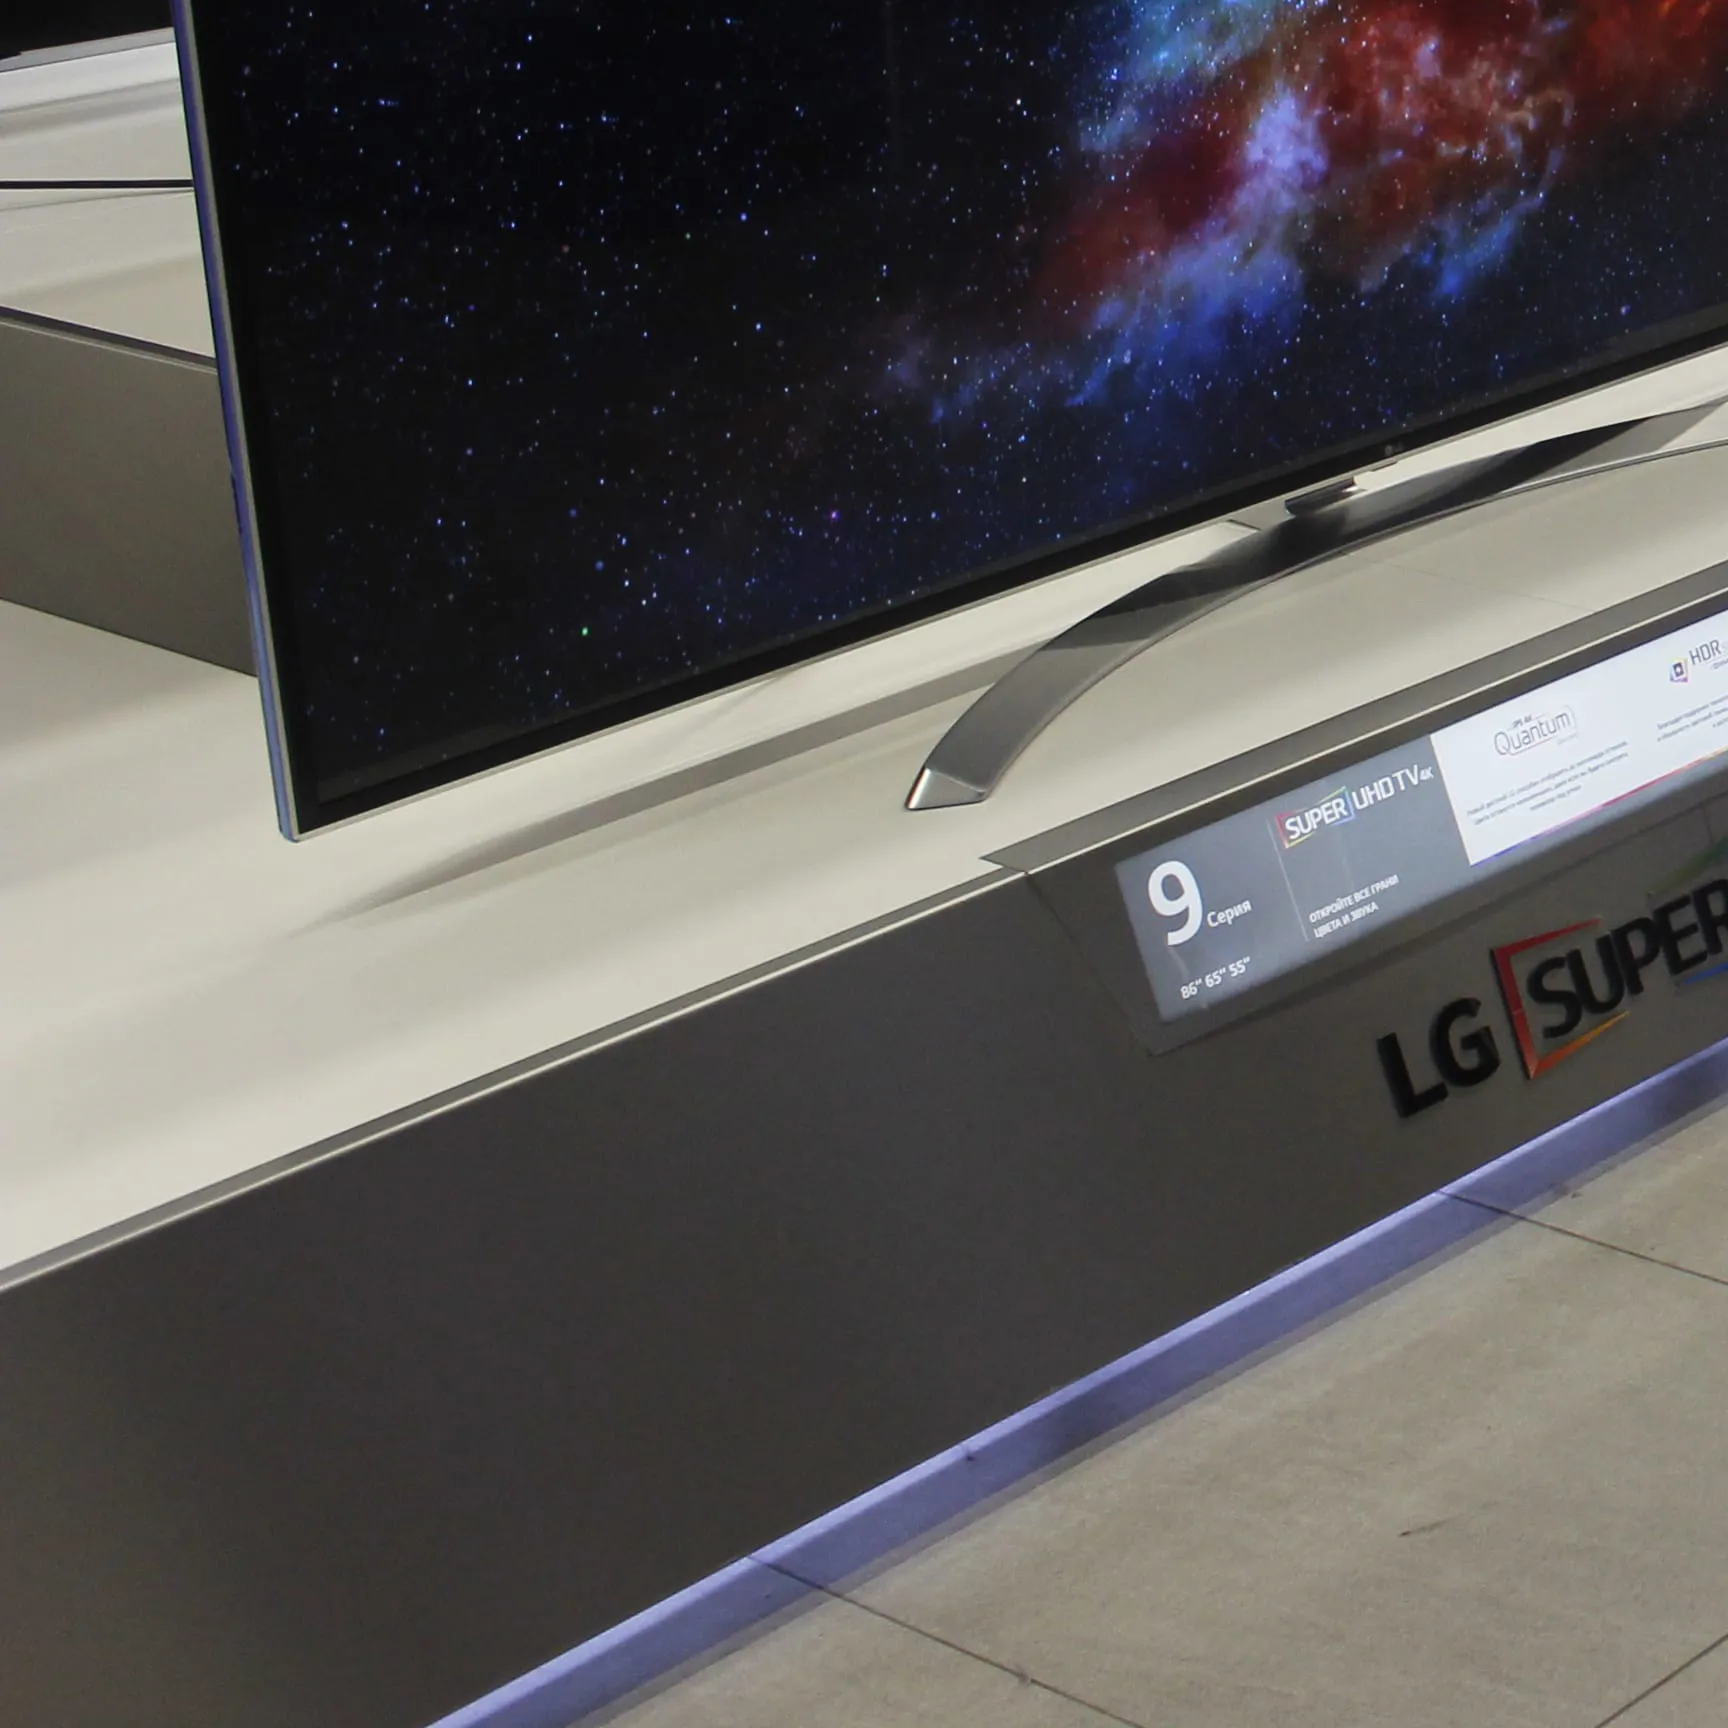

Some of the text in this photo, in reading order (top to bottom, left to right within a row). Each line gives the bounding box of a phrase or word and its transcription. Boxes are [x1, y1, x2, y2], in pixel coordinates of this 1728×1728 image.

[1689, 639, 1721, 665] HDR
[1493, 712, 1572, 755] Quantum
[1285, 797, 1349, 839] SUPER
[1352, 777, 1395, 810] UHD
[1147, 860, 1204, 945] 9
[1206, 899, 1252, 927] Серия
[1309, 874, 1400, 923] ОТКРОЙТЕ ВСЕ ГРАНИ
[1313, 901, 1380, 939] ЦВЕТА И ЗВУКА
[1376, 997, 1501, 1118] LG
